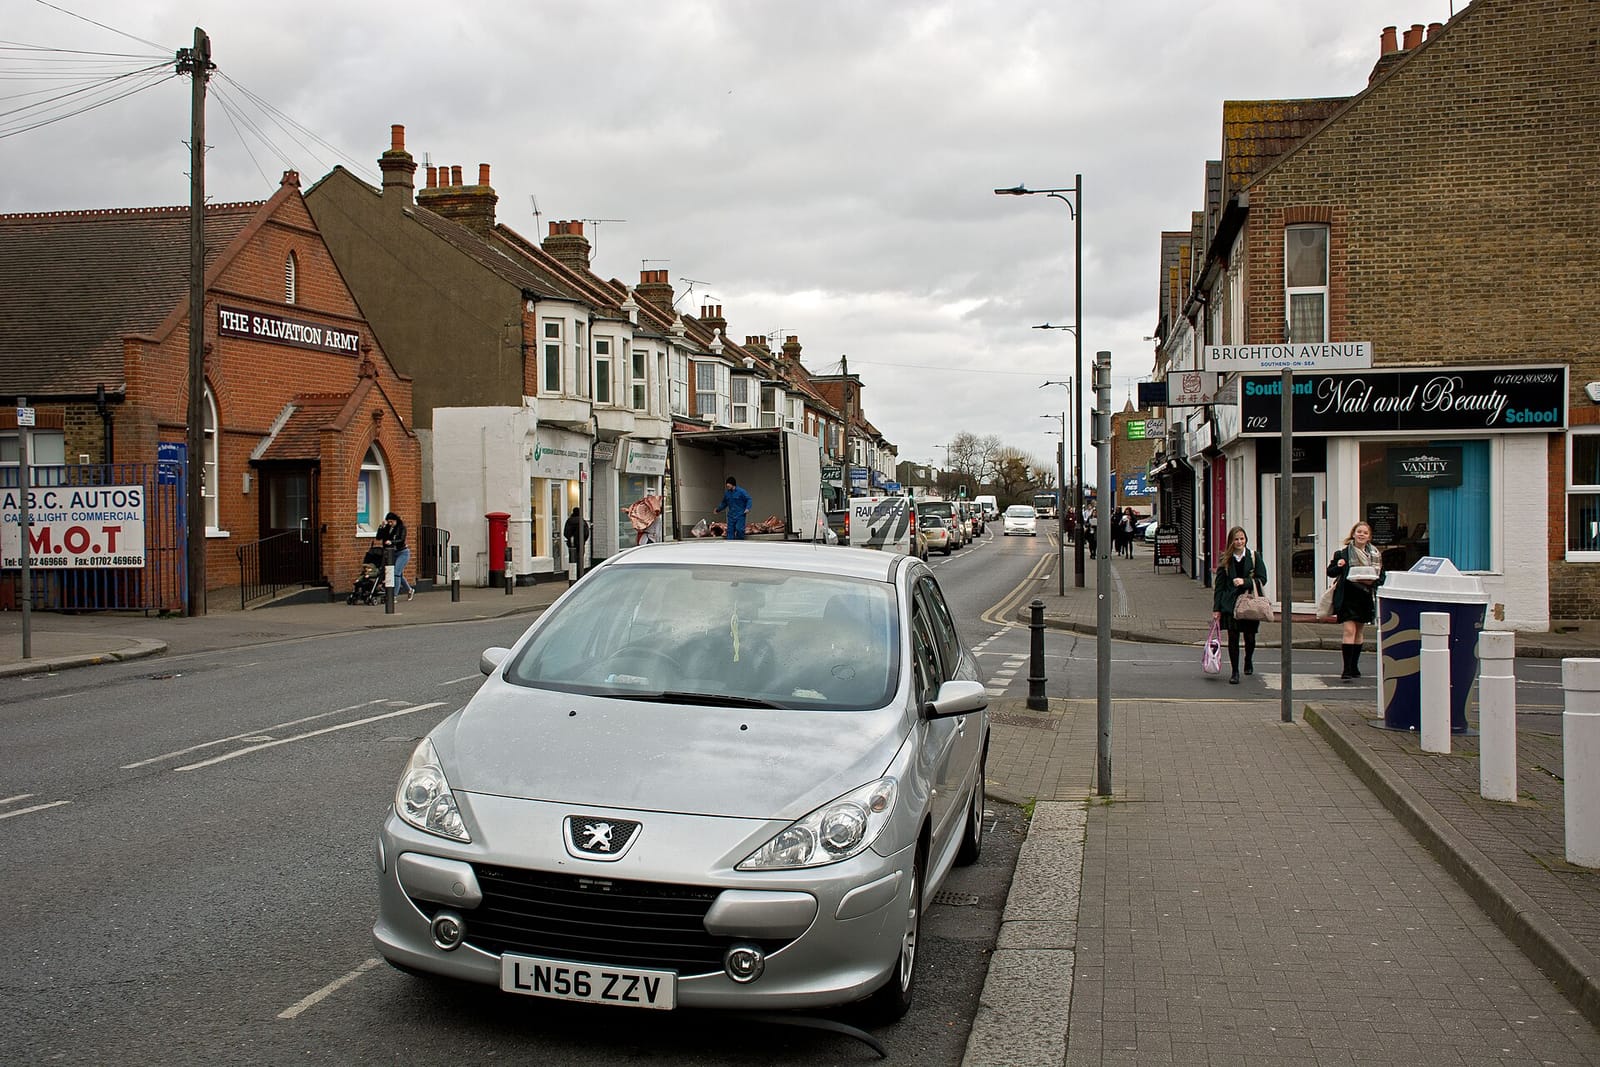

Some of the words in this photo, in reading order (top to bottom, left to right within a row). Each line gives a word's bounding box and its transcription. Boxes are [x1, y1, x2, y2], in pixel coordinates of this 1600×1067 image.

[220, 310, 249, 333] THE
[253, 316, 322, 345] SALVATION
[324, 330, 359, 351] ARMY
[1212, 346, 1295, 360] BRIGHTON
[1299, 344, 1364, 357] AVENUE
[1313, 377, 1370, 414] Nail
[1373, 385, 1415, 412] and
[1421, 376, 1509, 425] Beauty
[1247, 416, 1268, 428] 702
[1505, 407, 1558, 423] School
[1402, 462, 1448, 471] VANITY
[3, 492, 63, 510] A.B.C.
[70, 490, 141, 509] AUTOS
[36, 512, 68, 522] LIGHT
[71, 511, 139, 521] COMMERCIAL
[28, 526, 121, 555] M.O.T
[4, 557, 17, 566] Tel:
[18, 557, 38, 566] 002
[40, 557, 68, 566] 469666
[75, 556, 89, 566] Fax:
[90, 556, 111, 566] 01702
[112, 555, 143, 565] 469666
[514, 962, 592, 998] LN56
[601, 972, 661, 1003] ZZV
